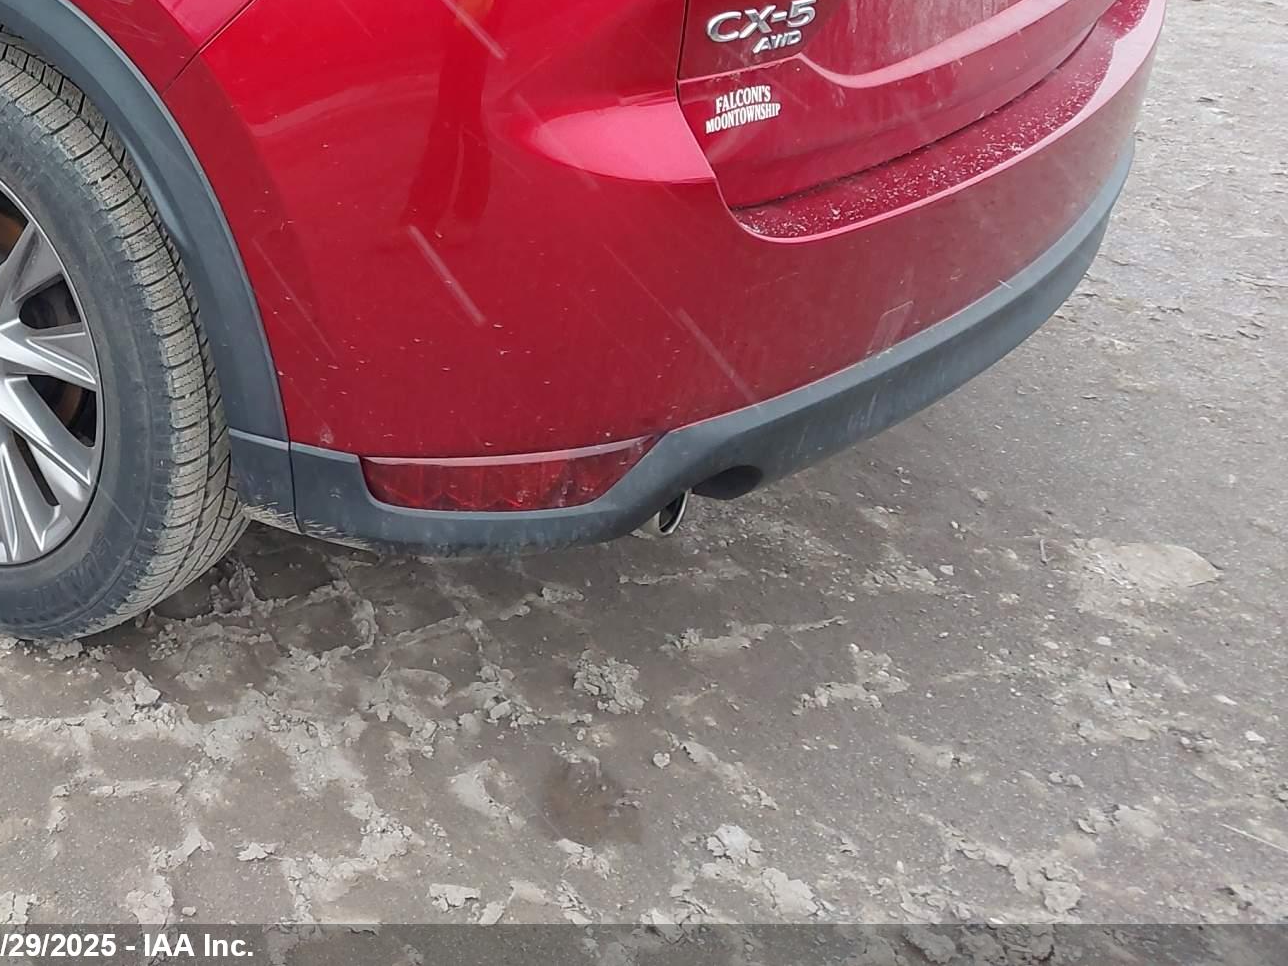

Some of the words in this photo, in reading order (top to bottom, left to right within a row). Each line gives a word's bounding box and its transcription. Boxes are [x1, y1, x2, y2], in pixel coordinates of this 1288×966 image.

[752, 30, 802, 54] AWD
[715, 85, 772, 115] FALCONI'S
[705, 103, 781, 134] MOONTOWNSHIP
